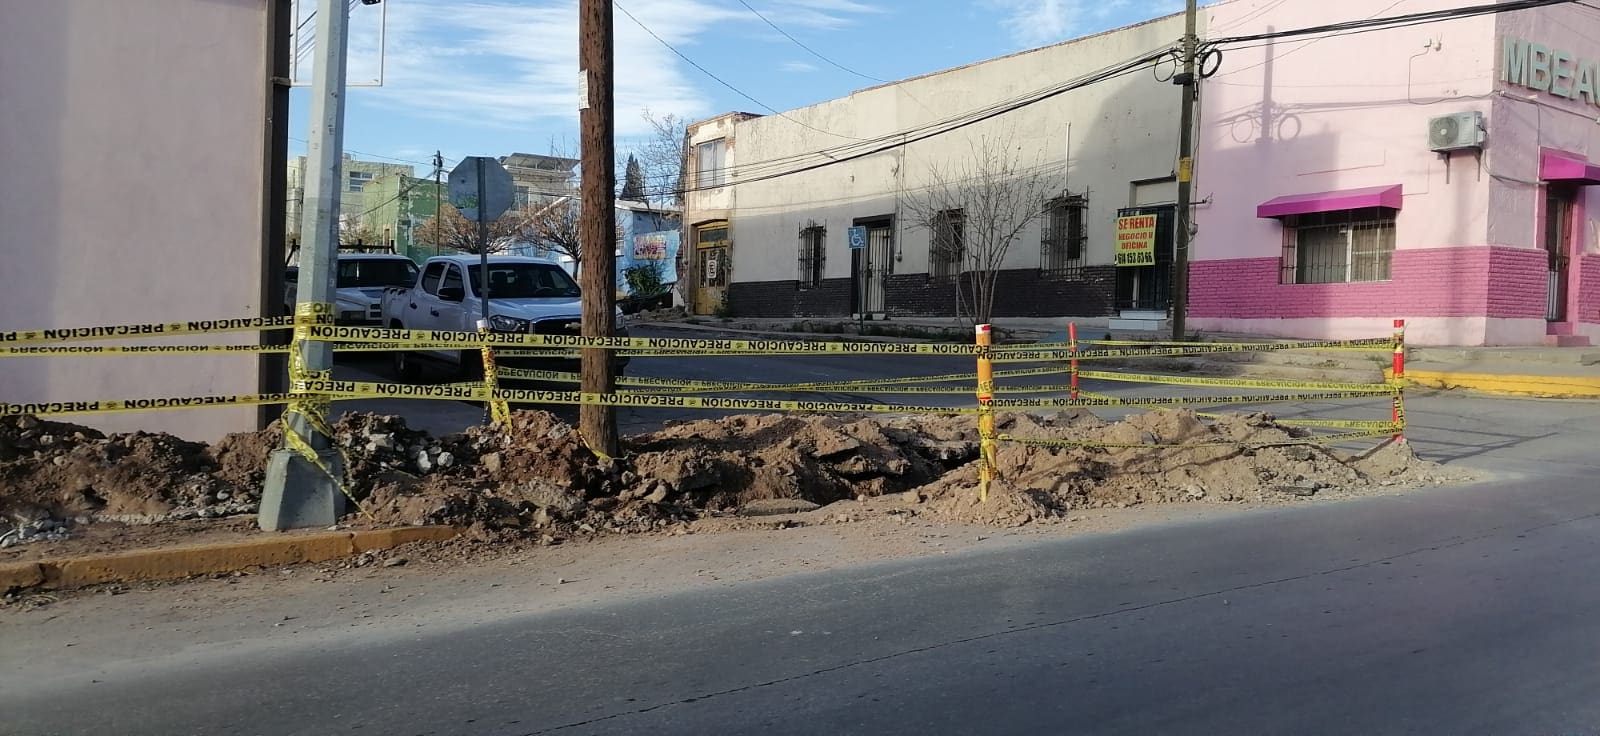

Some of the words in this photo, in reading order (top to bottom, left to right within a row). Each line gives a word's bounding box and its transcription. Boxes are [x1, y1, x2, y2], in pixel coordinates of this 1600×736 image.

[1503, 36, 1600, 108] MBEA
[1119, 219, 1128, 230] SE
[1130, 216, 1154, 229] RENTA
[1119, 232, 1147, 240] NEGOCIO
[1122, 241, 1148, 249] OFICINA
